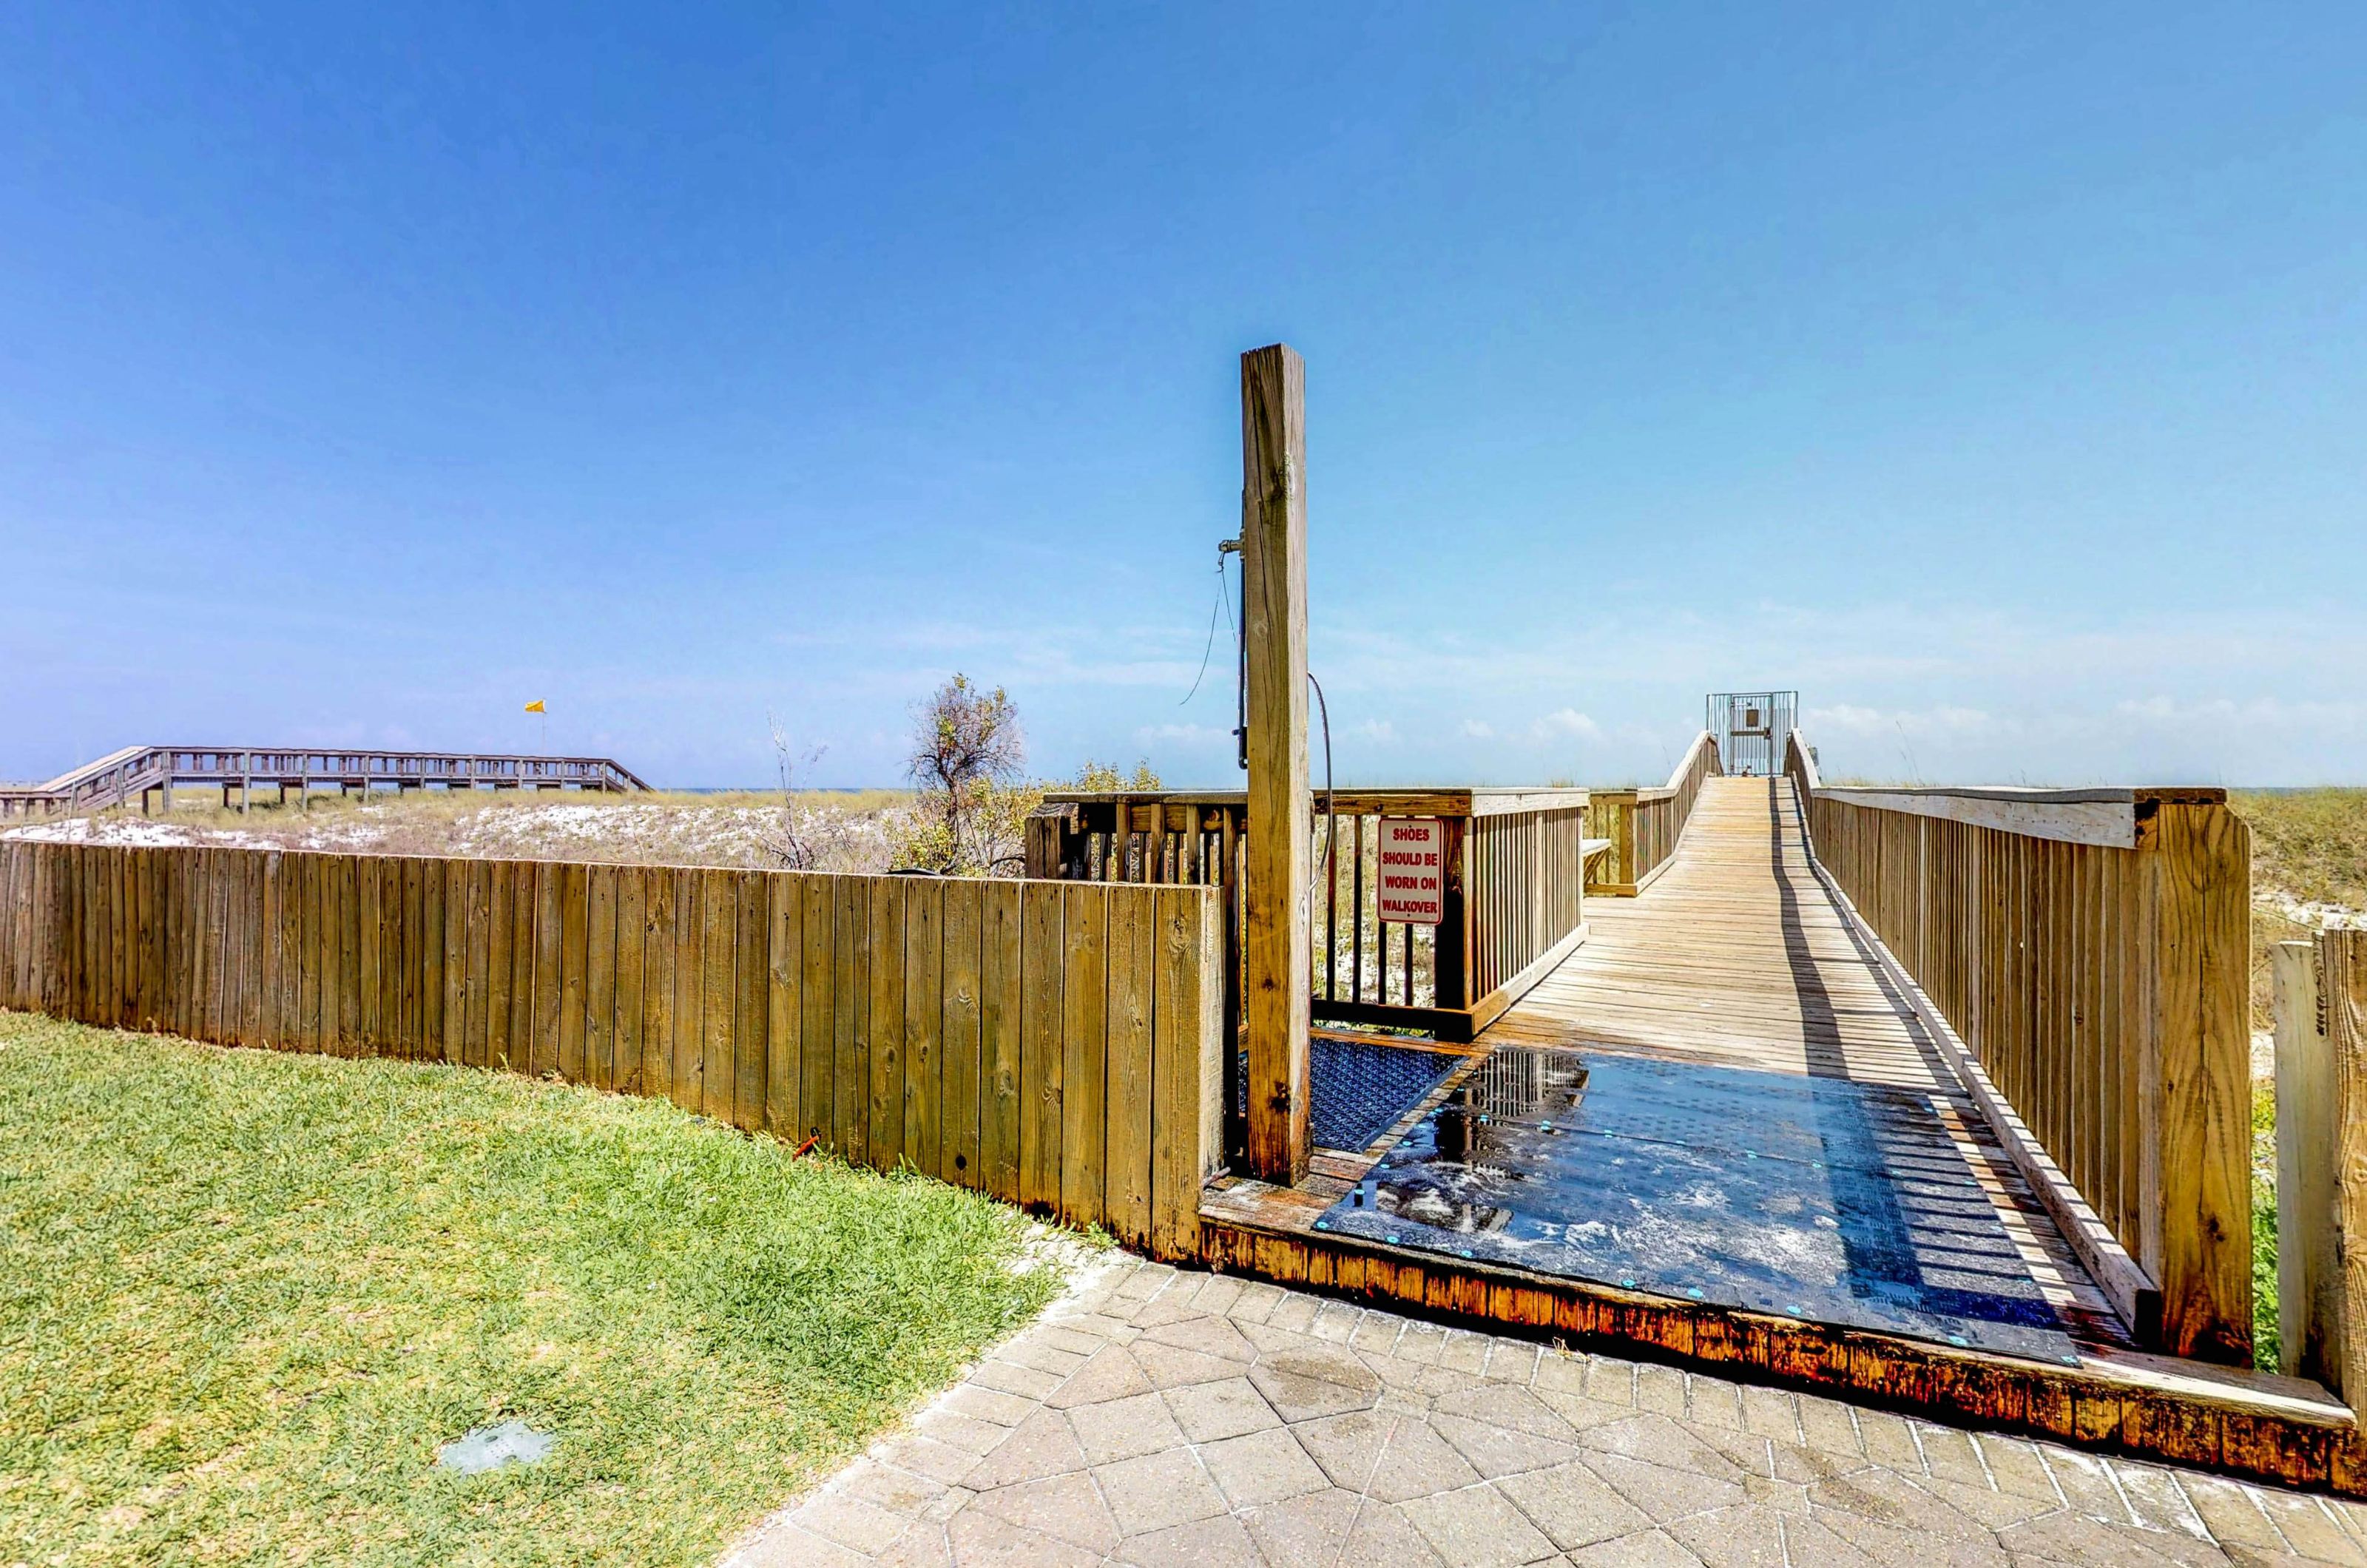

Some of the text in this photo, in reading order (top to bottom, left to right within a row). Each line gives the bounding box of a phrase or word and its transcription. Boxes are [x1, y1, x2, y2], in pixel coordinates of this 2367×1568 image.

[1393, 828, 1430, 842] SHOES
[1382, 851, 1437, 866] SHOULD BE
[1385, 875, 1436, 890] WORN ON
[1382, 899, 1437, 913] WALKOVER
